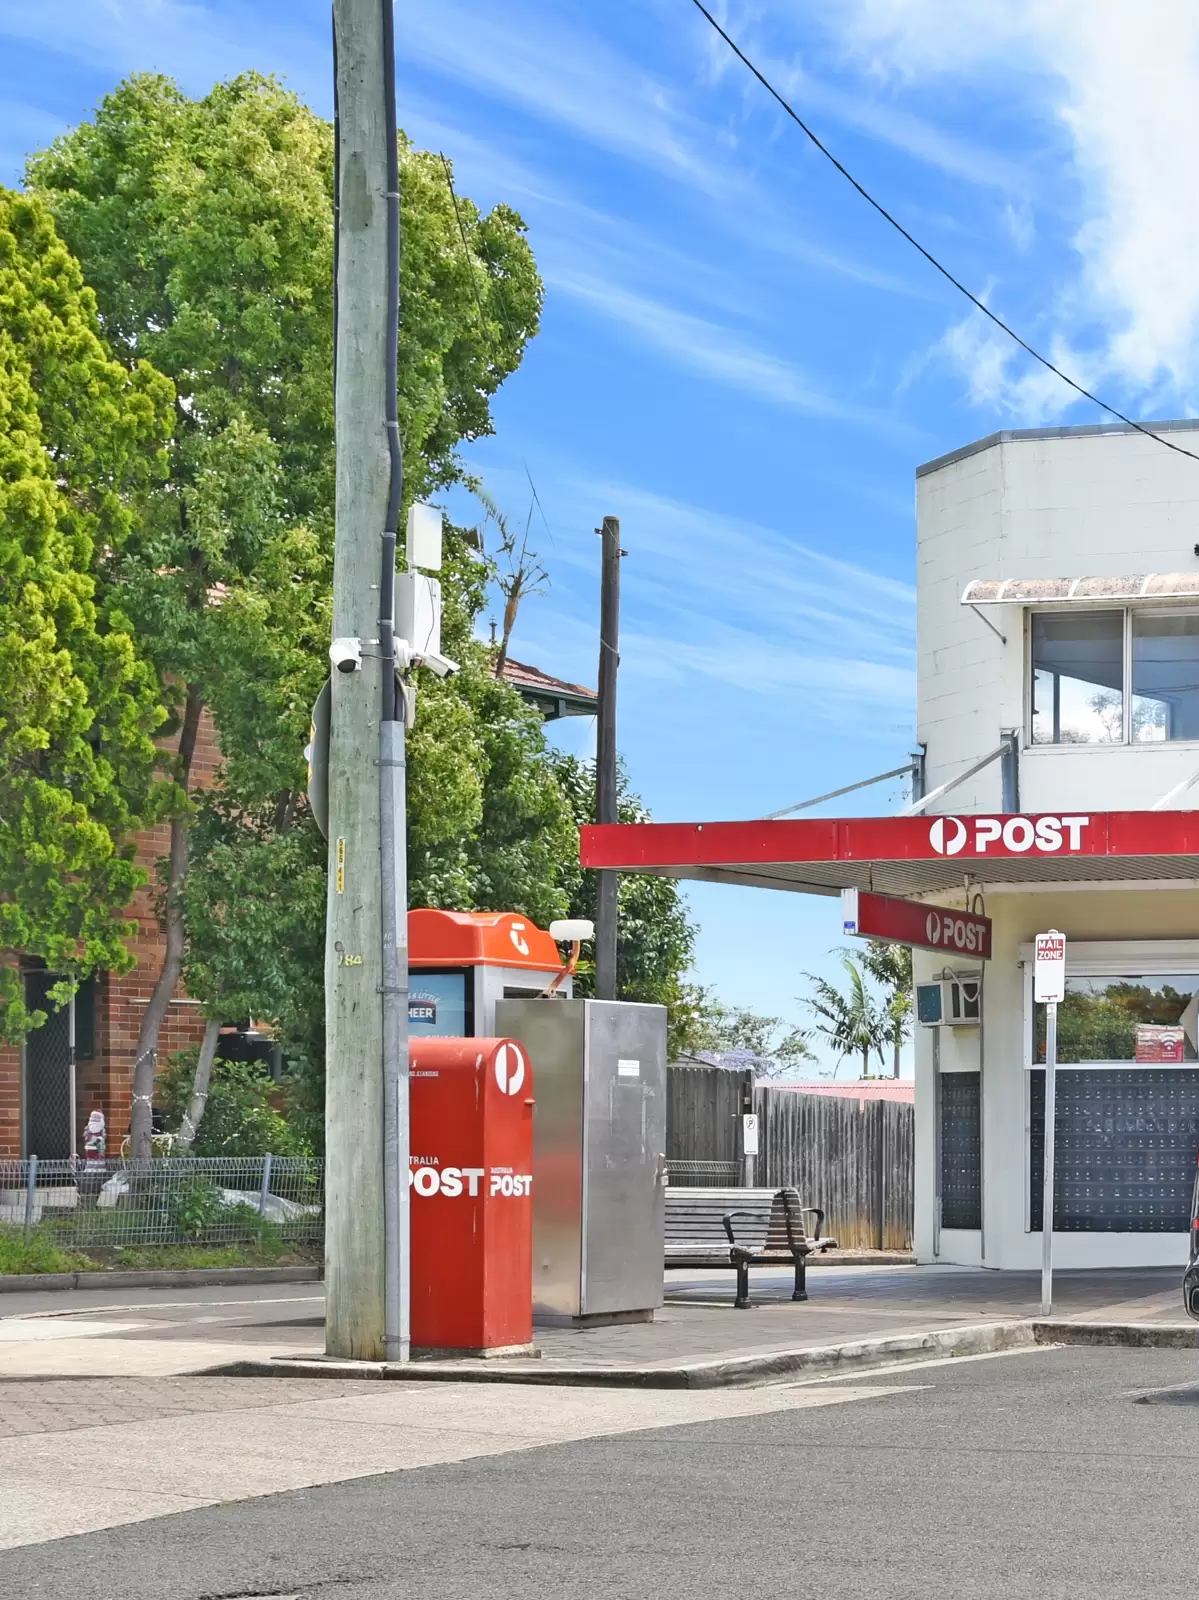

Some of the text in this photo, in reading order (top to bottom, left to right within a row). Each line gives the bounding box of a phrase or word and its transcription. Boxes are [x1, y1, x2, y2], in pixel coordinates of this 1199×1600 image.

[975, 816, 1089, 852] POST
[943, 917, 986, 951] POST
[1038, 939, 1063, 949] MAIL
[1038, 950, 1063, 960] ZONE
[408, 1007, 433, 1019] HEER
[409, 1155, 440, 1165] TRALIA
[408, 1167, 485, 1197] OST
[490, 1175, 533, 1197] POST
